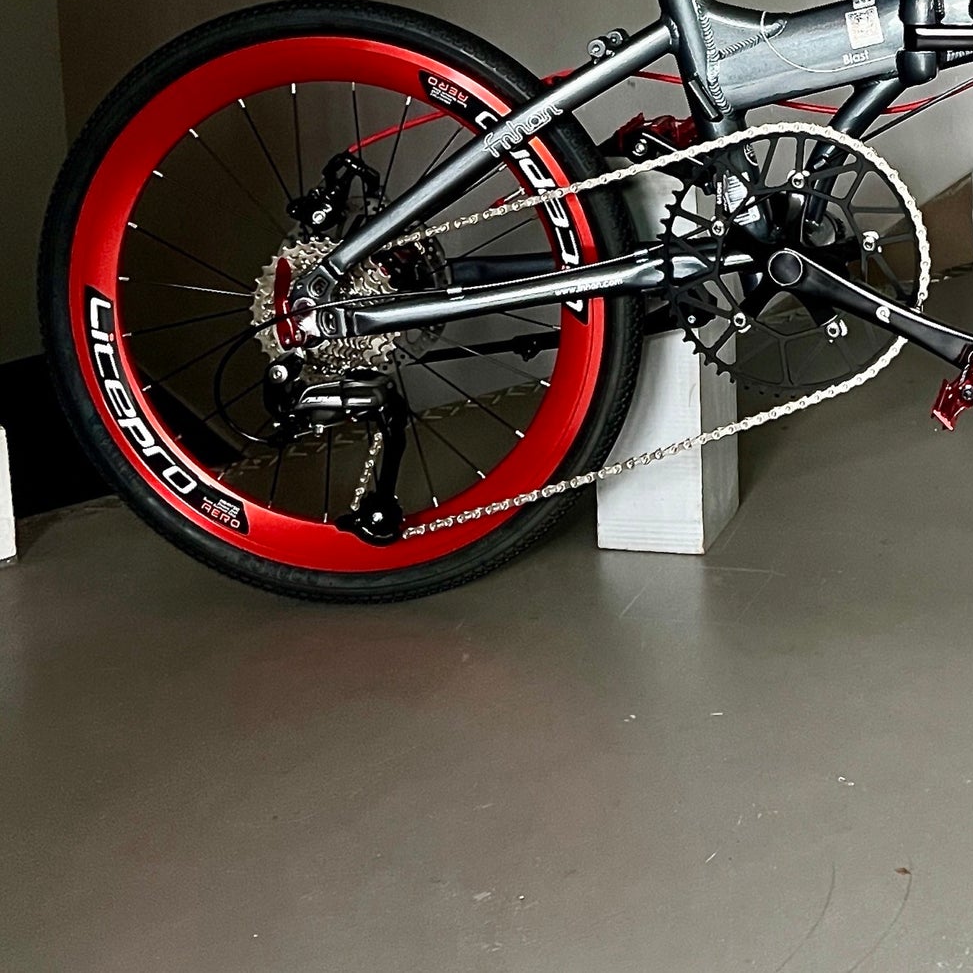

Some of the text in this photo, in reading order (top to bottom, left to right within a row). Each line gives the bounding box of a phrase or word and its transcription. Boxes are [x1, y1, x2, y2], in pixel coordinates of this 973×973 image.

[842, 49, 870, 66] Blast
[428, 76, 469, 102] AERO
[90, 297, 197, 495] Litepro
[201, 502, 240, 528] AERO
